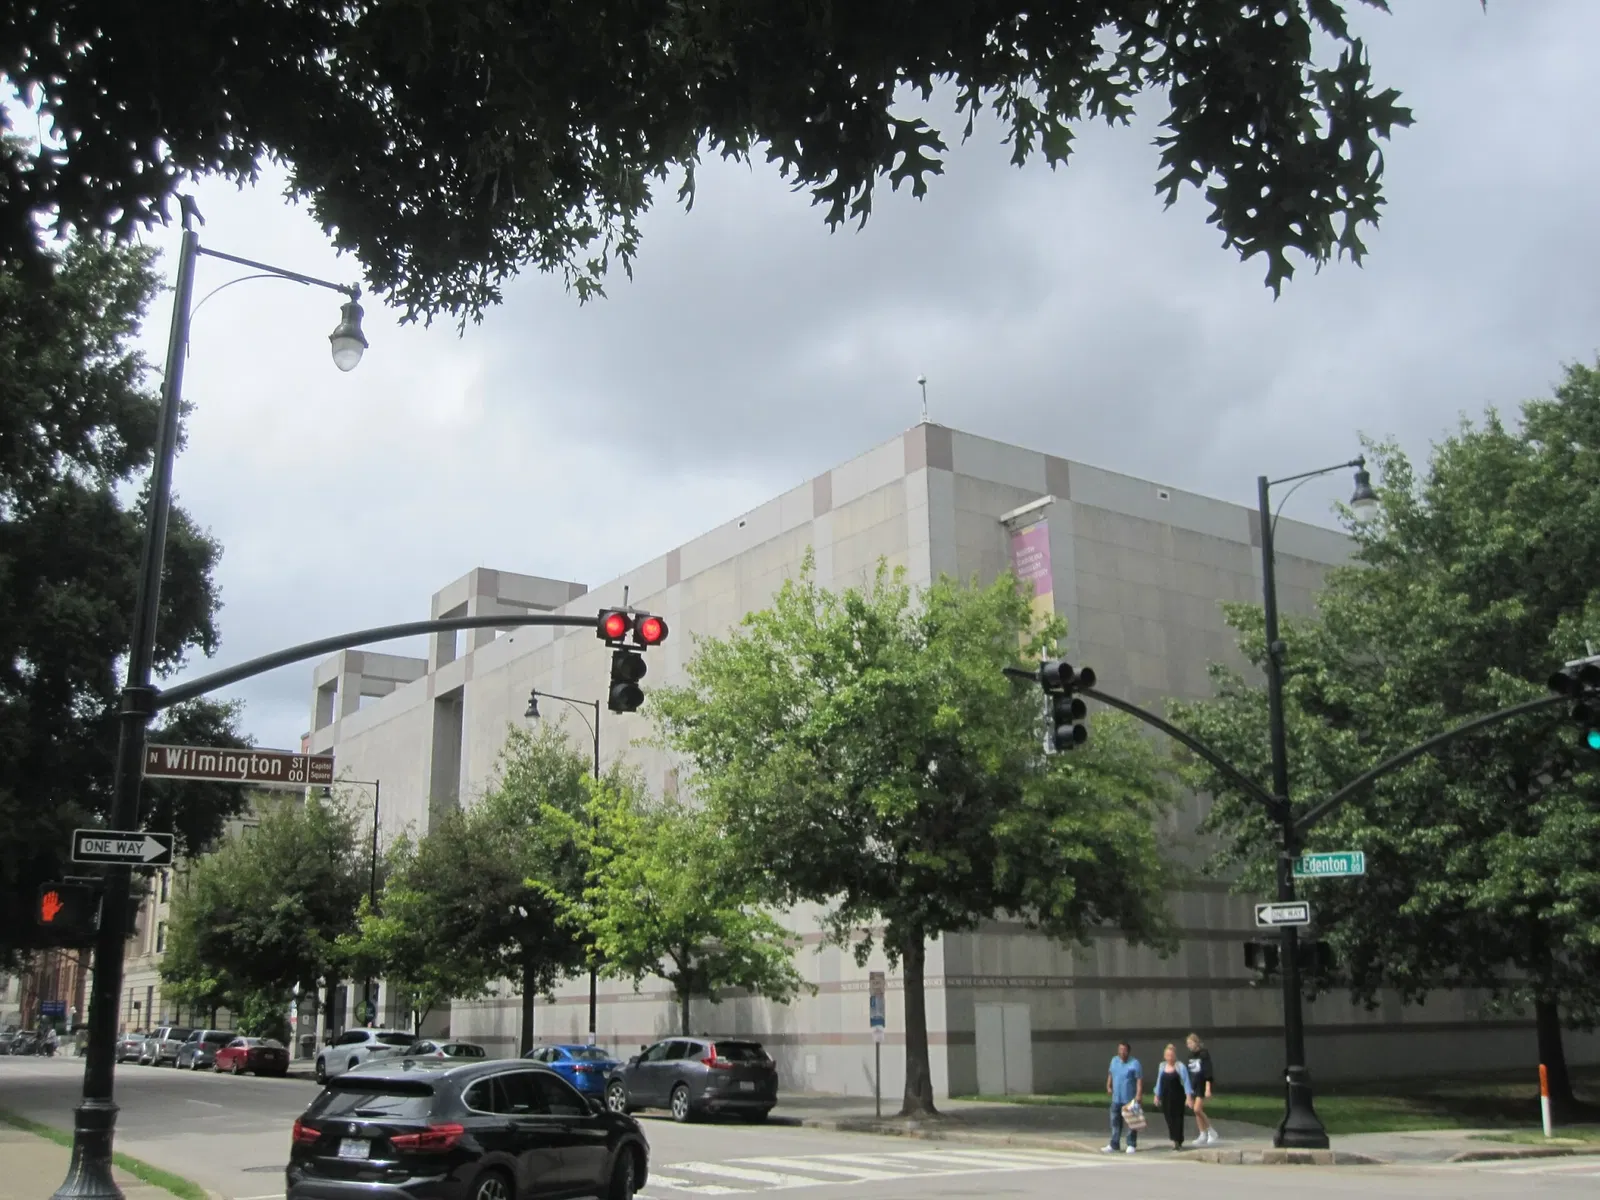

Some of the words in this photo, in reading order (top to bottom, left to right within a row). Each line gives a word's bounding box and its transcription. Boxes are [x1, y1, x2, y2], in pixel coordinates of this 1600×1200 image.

[150, 751, 158, 764] N
[165, 747, 282, 780] Wilmington
[292, 757, 304, 769] ST
[311, 761, 332, 771] Capitol
[288, 769, 304, 782] 00
[310, 771, 331, 780] Square
[84, 840, 112, 853] ONE
[116, 841, 145, 854] WAY
[1303, 856, 1348, 873] Edenton
